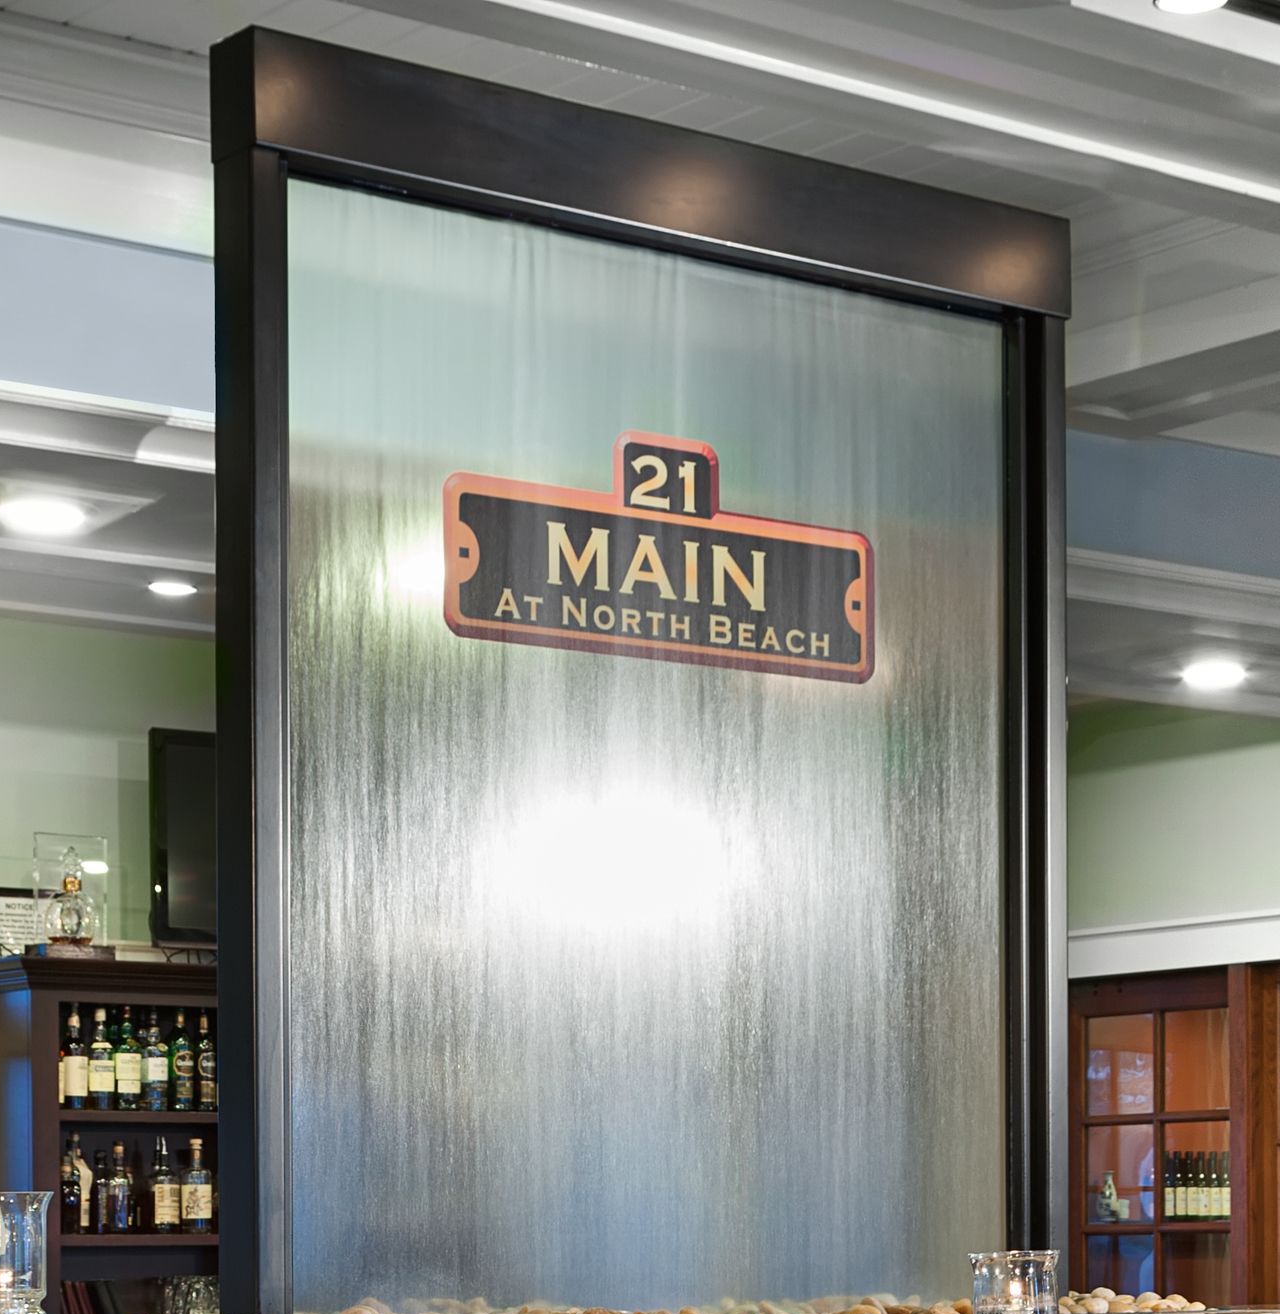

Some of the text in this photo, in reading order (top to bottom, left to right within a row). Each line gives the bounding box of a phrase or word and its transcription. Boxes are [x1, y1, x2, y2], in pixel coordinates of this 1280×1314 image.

[630, 454, 698, 514] 21
[546, 520, 767, 612] MAIN
[5, 903, 33, 911] NOTICE
